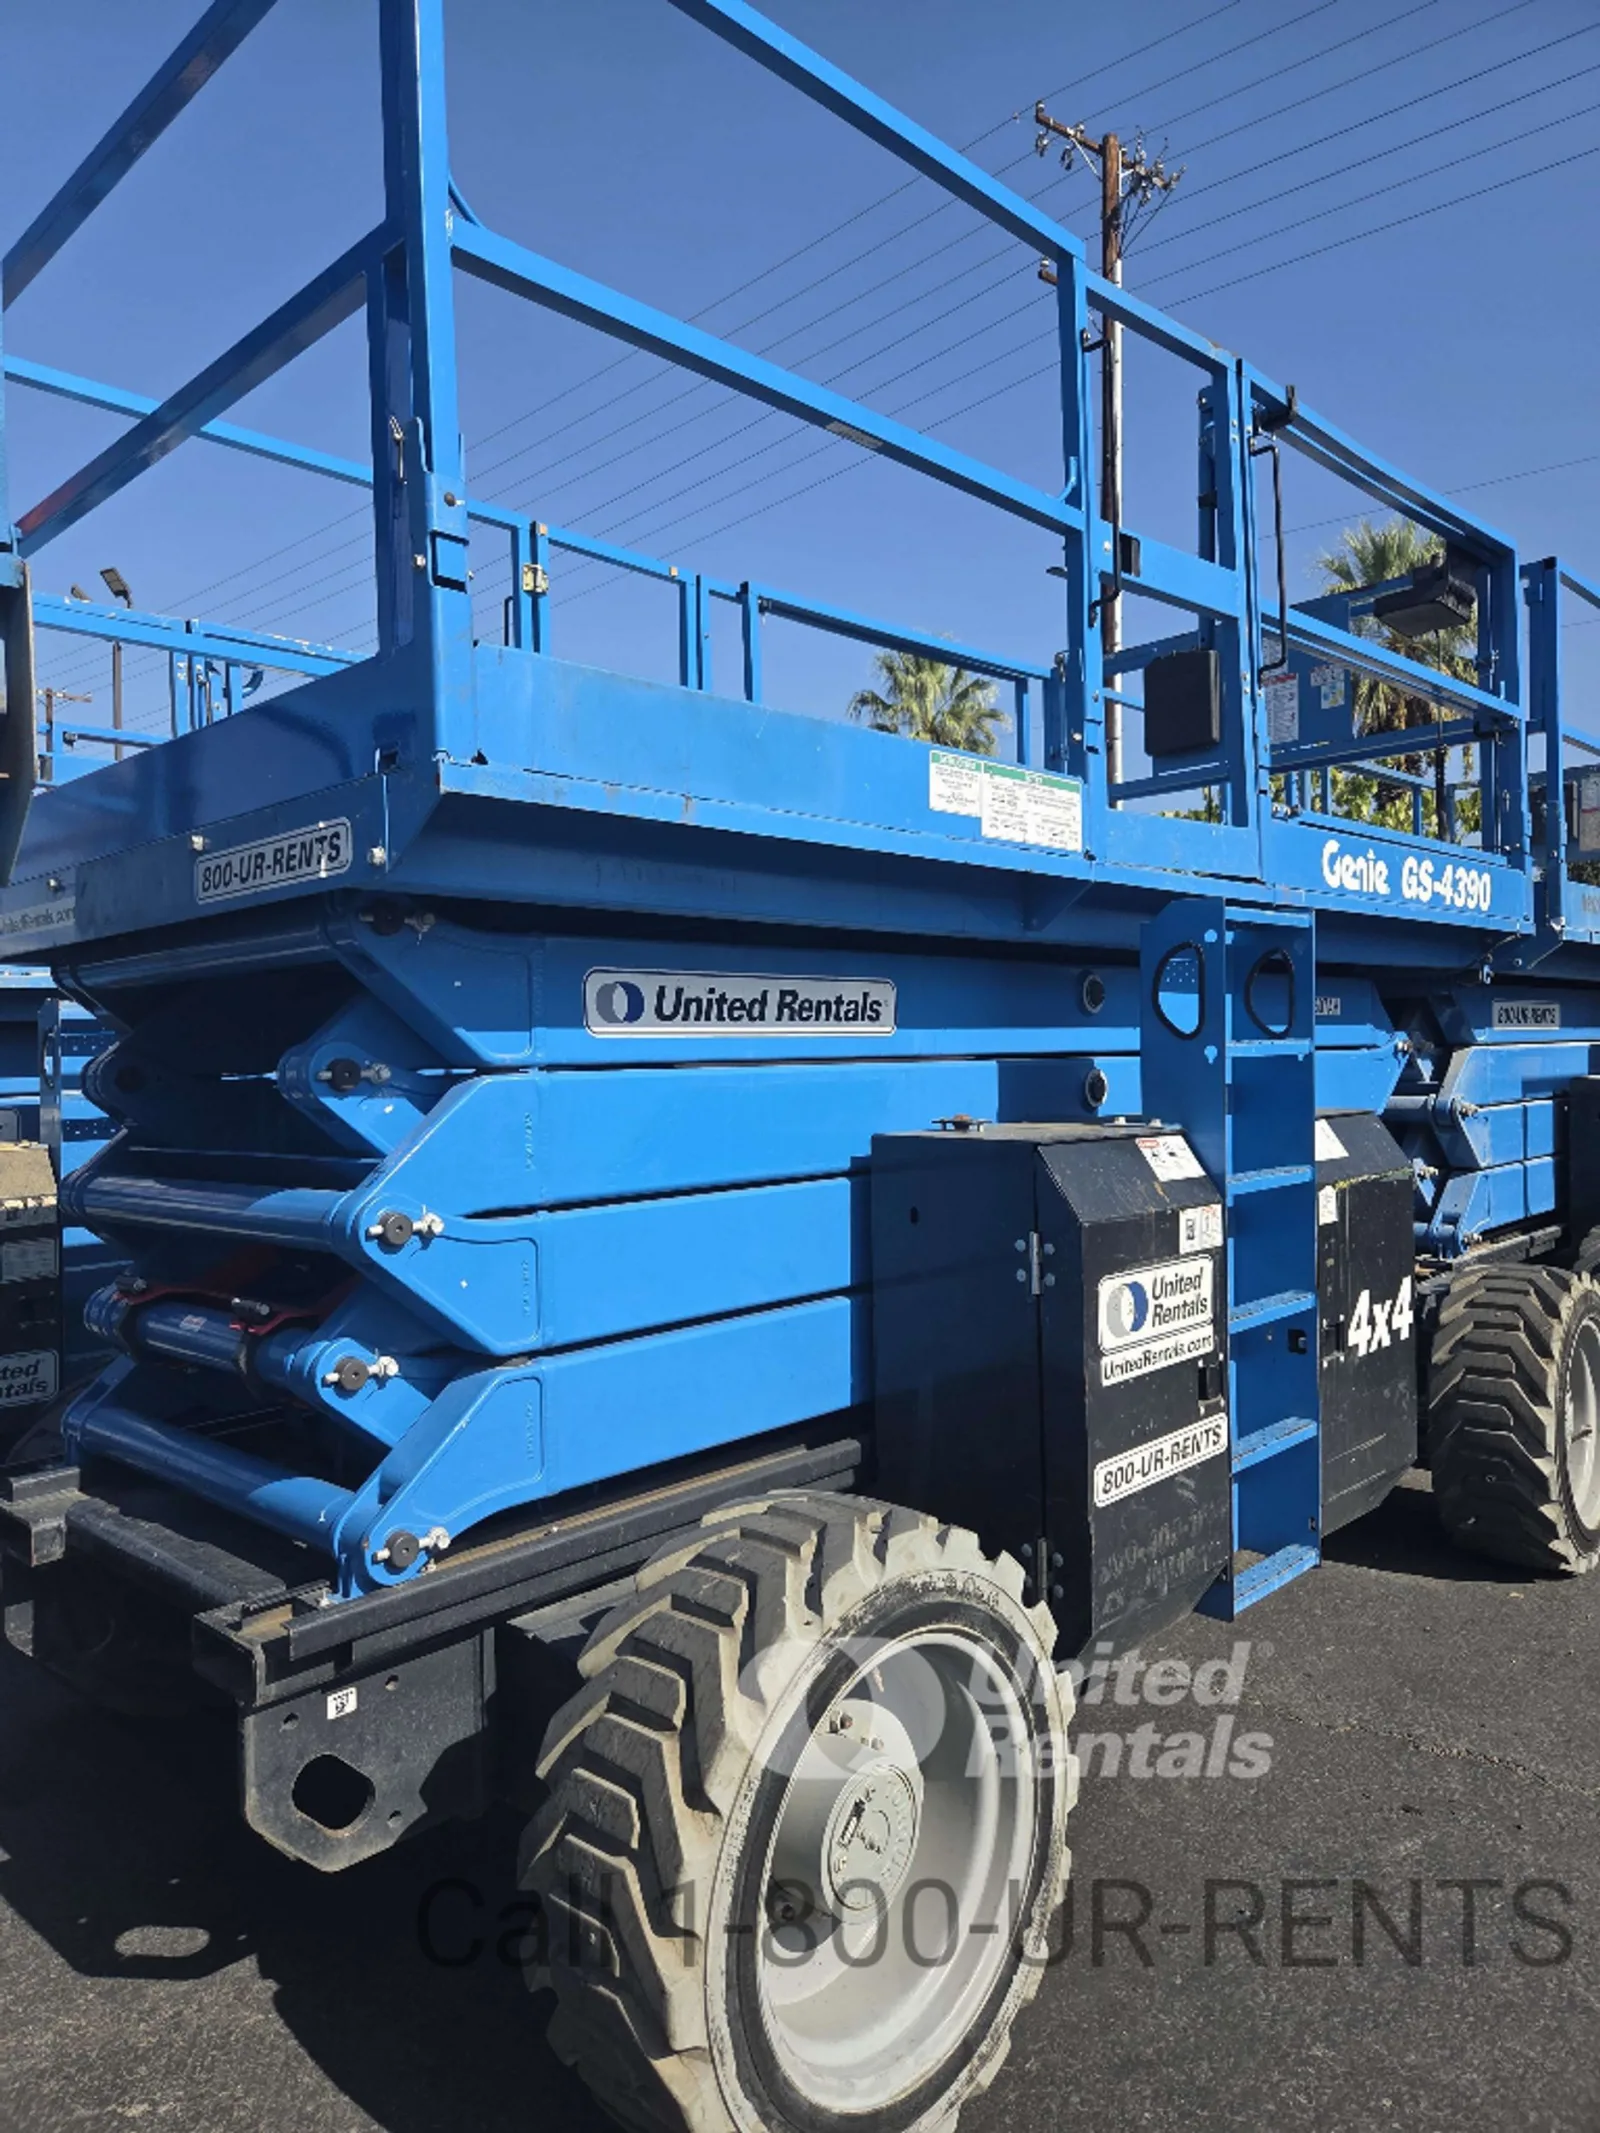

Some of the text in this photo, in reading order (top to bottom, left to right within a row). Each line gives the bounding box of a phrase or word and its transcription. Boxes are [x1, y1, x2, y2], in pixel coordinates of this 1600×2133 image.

[201, 830, 342, 893] 800-UR-RENTS
[1321, 838, 1492, 912] Genie GS-4390
[654, 985, 883, 1023] United Rentals
[1151, 1266, 1204, 1301] United
[1151, 1293, 1208, 1328] Rentals
[1347, 1275, 1415, 1358] 4x4
[1103, 1335, 1212, 1380] UnitedRentals.com
[1100, 1423, 1223, 1495] 800-UR-RENTS
